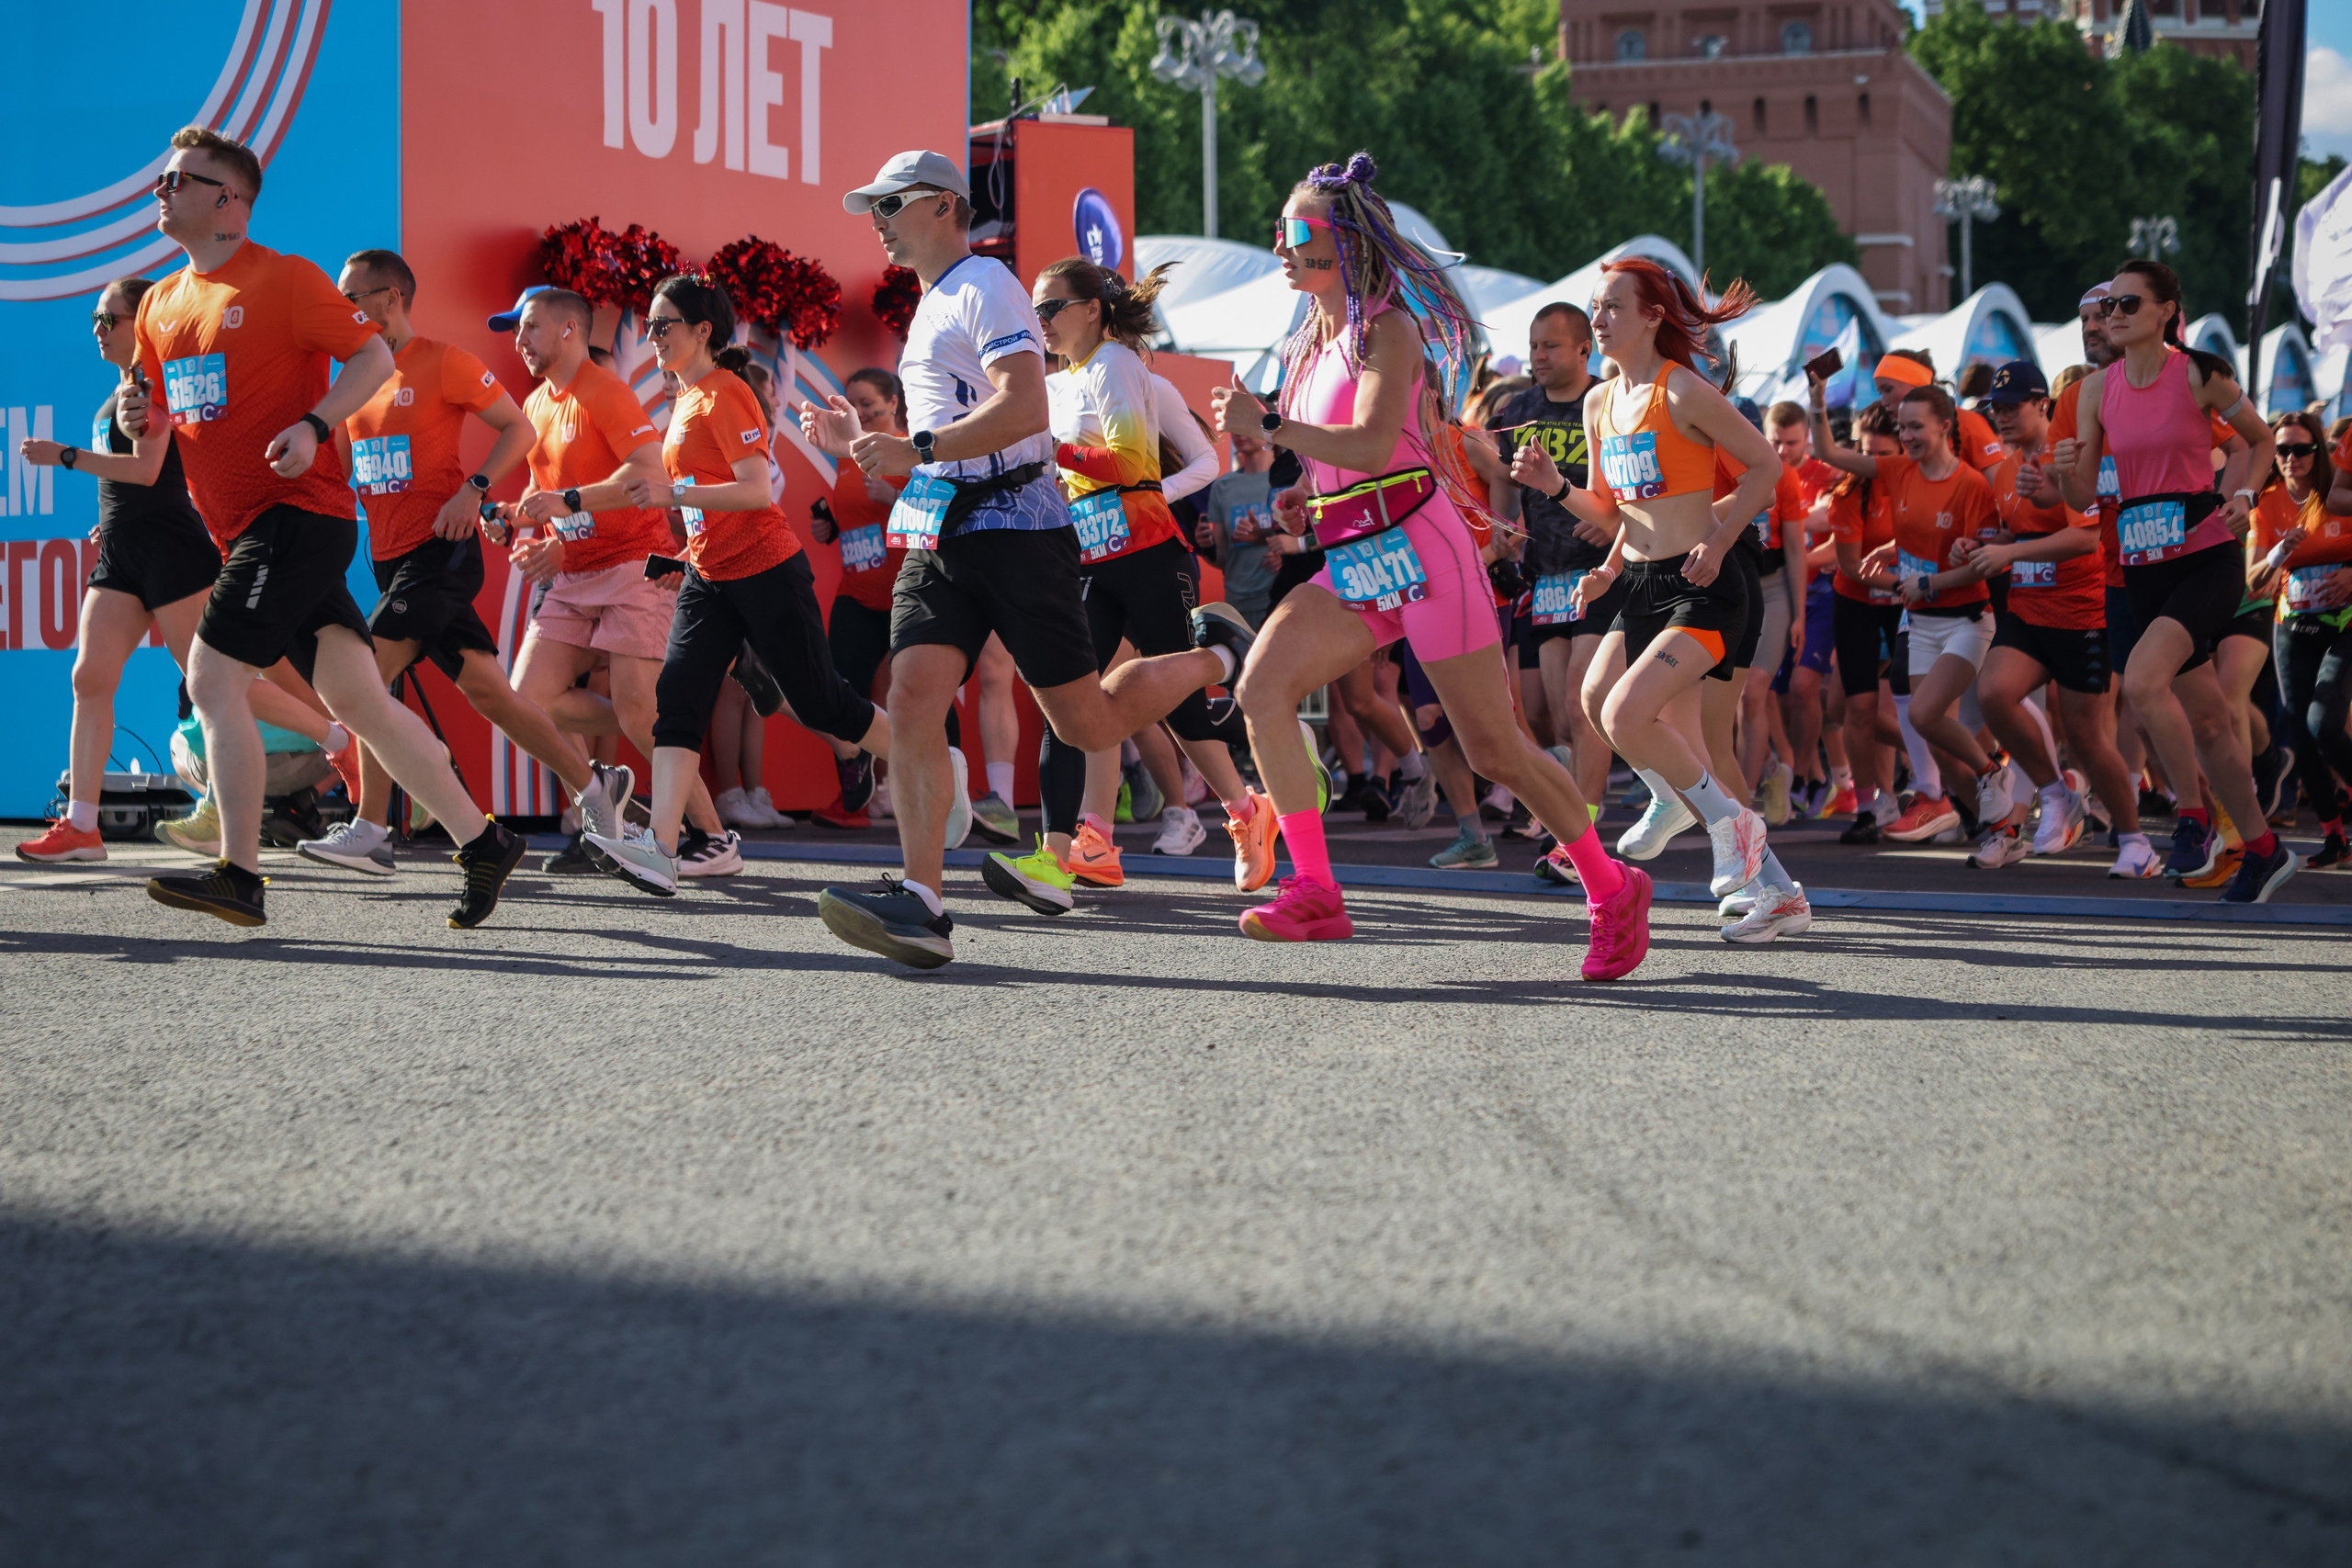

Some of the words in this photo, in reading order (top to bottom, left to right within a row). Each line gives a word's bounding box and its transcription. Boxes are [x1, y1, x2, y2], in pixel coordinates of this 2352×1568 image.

[592, 0, 678, 159] 10
[694, 0, 833, 186] ЛЕТ
[221, 306, 243, 330] 10
[168, 371, 220, 412] 31526
[393, 387, 414, 407] 10
[186, 408, 200, 424] 5KM
[202, 405, 215, 422] C
[0, 405, 53, 516] М
[355, 450, 408, 485] 35940
[1603, 450, 1657, 487] 40709
[370, 482, 387, 496] 5KM
[388, 480, 401, 493] C
[1621, 485, 1637, 502] 5KM
[1642, 484, 1658, 499] C
[891, 496, 943, 532] 31807
[1083, 500, 1094, 515] 10
[1935, 512, 1954, 530] 10
[2324, 521, 2342, 539] 10
[578, 526, 589, 540] C
[2123, 515, 2182, 550] 40854
[842, 536, 884, 567] 32064
[1090, 543, 1108, 560] 5KM
[1108, 536, 1122, 552] C
[1355, 541, 1375, 558] 10
[2146, 547, 2164, 562] 5KM
[870, 557, 882, 569] C
[1341, 547, 1419, 599] 30471
[2042, 569, 2053, 581] C
[1376, 590, 1403, 612] 5KM
[1408, 584, 1425, 603] C
[1535, 584, 1577, 613] 3864
[1552, 612, 1567, 624] 5KM
